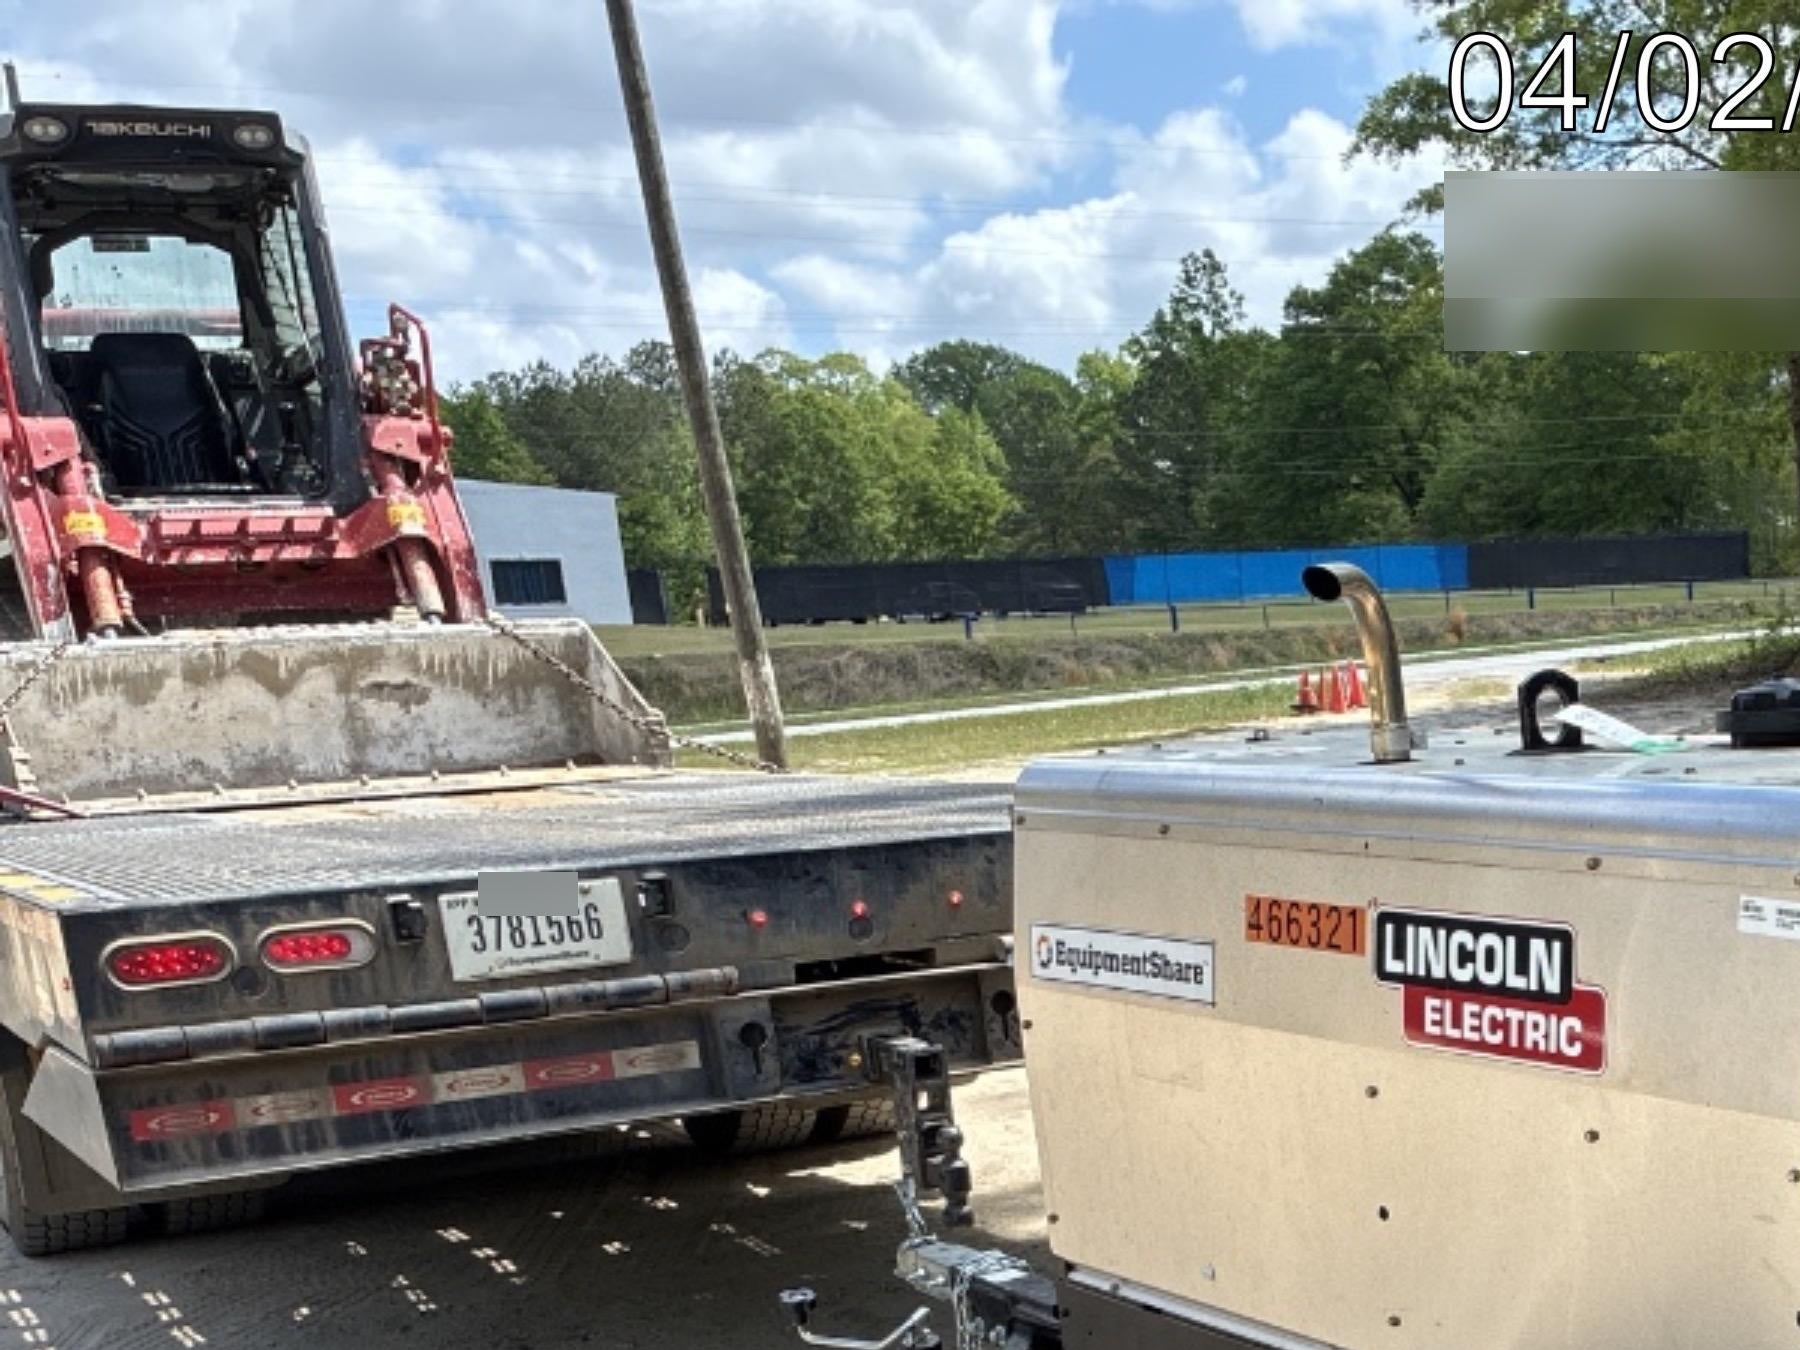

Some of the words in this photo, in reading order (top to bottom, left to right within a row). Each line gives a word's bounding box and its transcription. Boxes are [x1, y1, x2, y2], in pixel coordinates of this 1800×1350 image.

[1247, 896, 1360, 953] 466321
[1054, 939, 1205, 986] EquipmentShare
[1384, 922, 1563, 995] LINCOLN
[1423, 995, 1583, 1057] ELECTRIC
